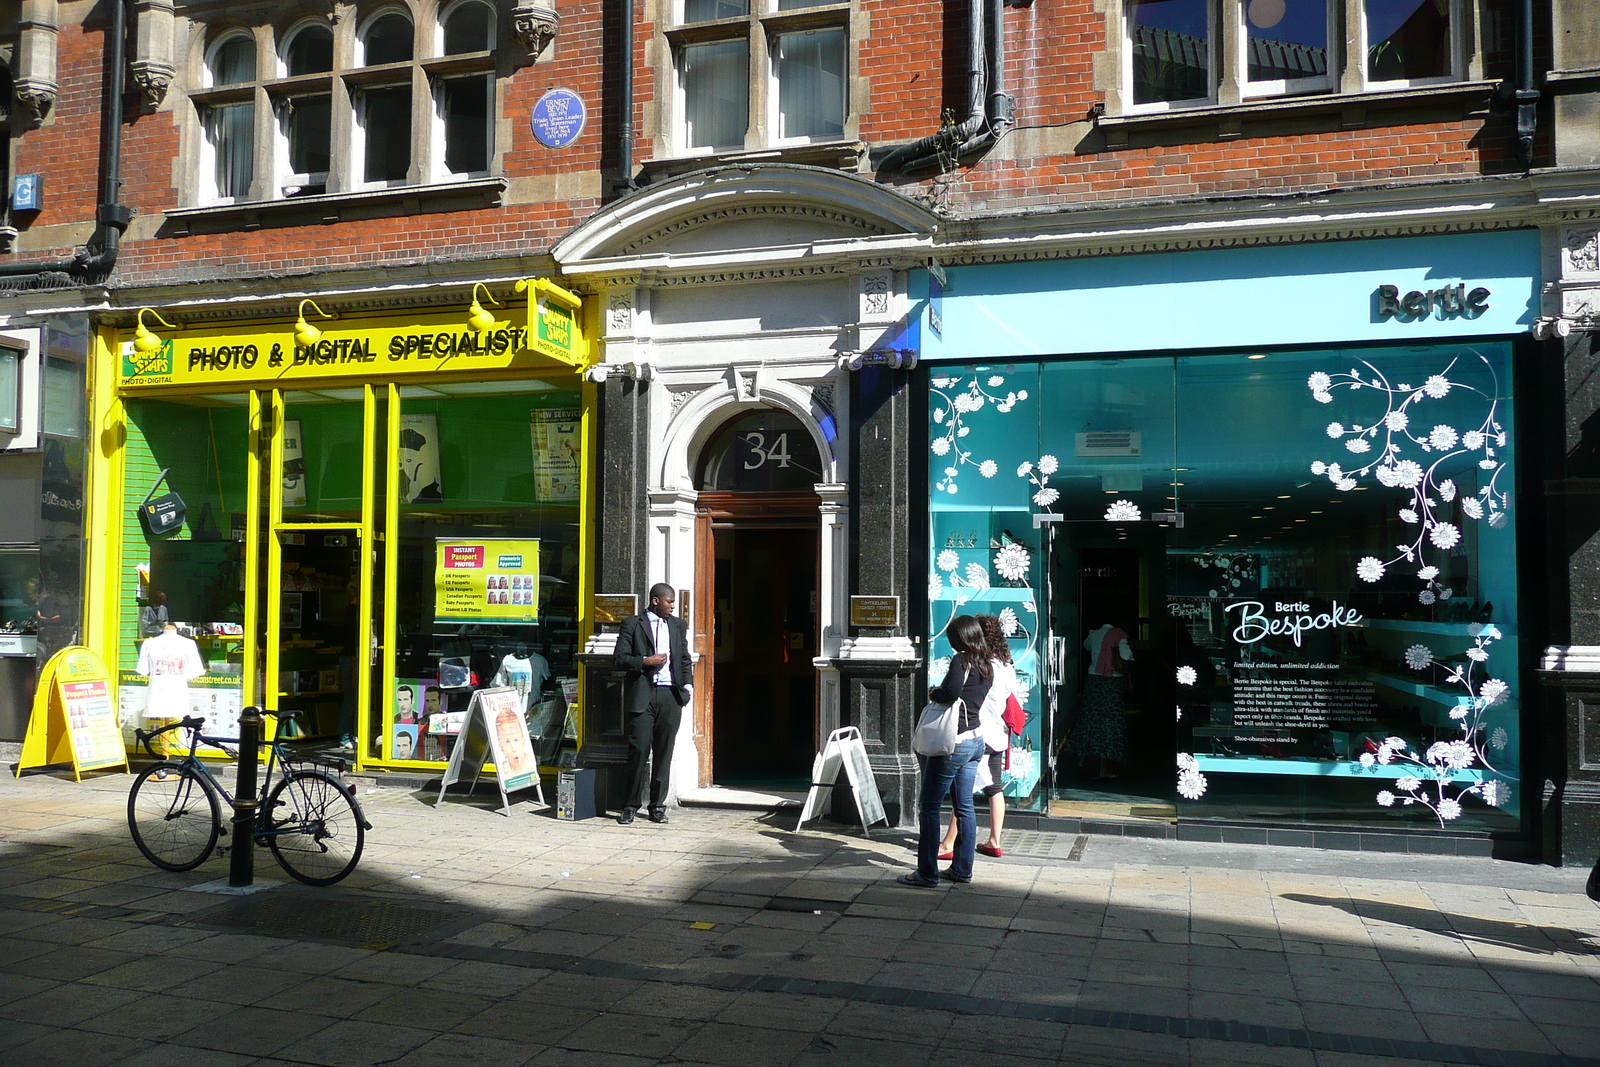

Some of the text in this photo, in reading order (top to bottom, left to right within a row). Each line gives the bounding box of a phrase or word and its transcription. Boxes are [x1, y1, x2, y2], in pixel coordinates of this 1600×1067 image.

[546, 98, 571, 106] ERNEST
[547, 104, 568, 112] BEVIN
[1380, 283, 1491, 314] Bertie
[546, 323, 568, 346] SNAPS
[190, 330, 528, 367] PHOTO & DIGITAL SPECIALIST
[134, 359, 168, 374] SNAPS
[744, 432, 791, 470] 34
[1275, 602, 1310, 612] Bertie
[1225, 600, 1363, 647] Bespoke
